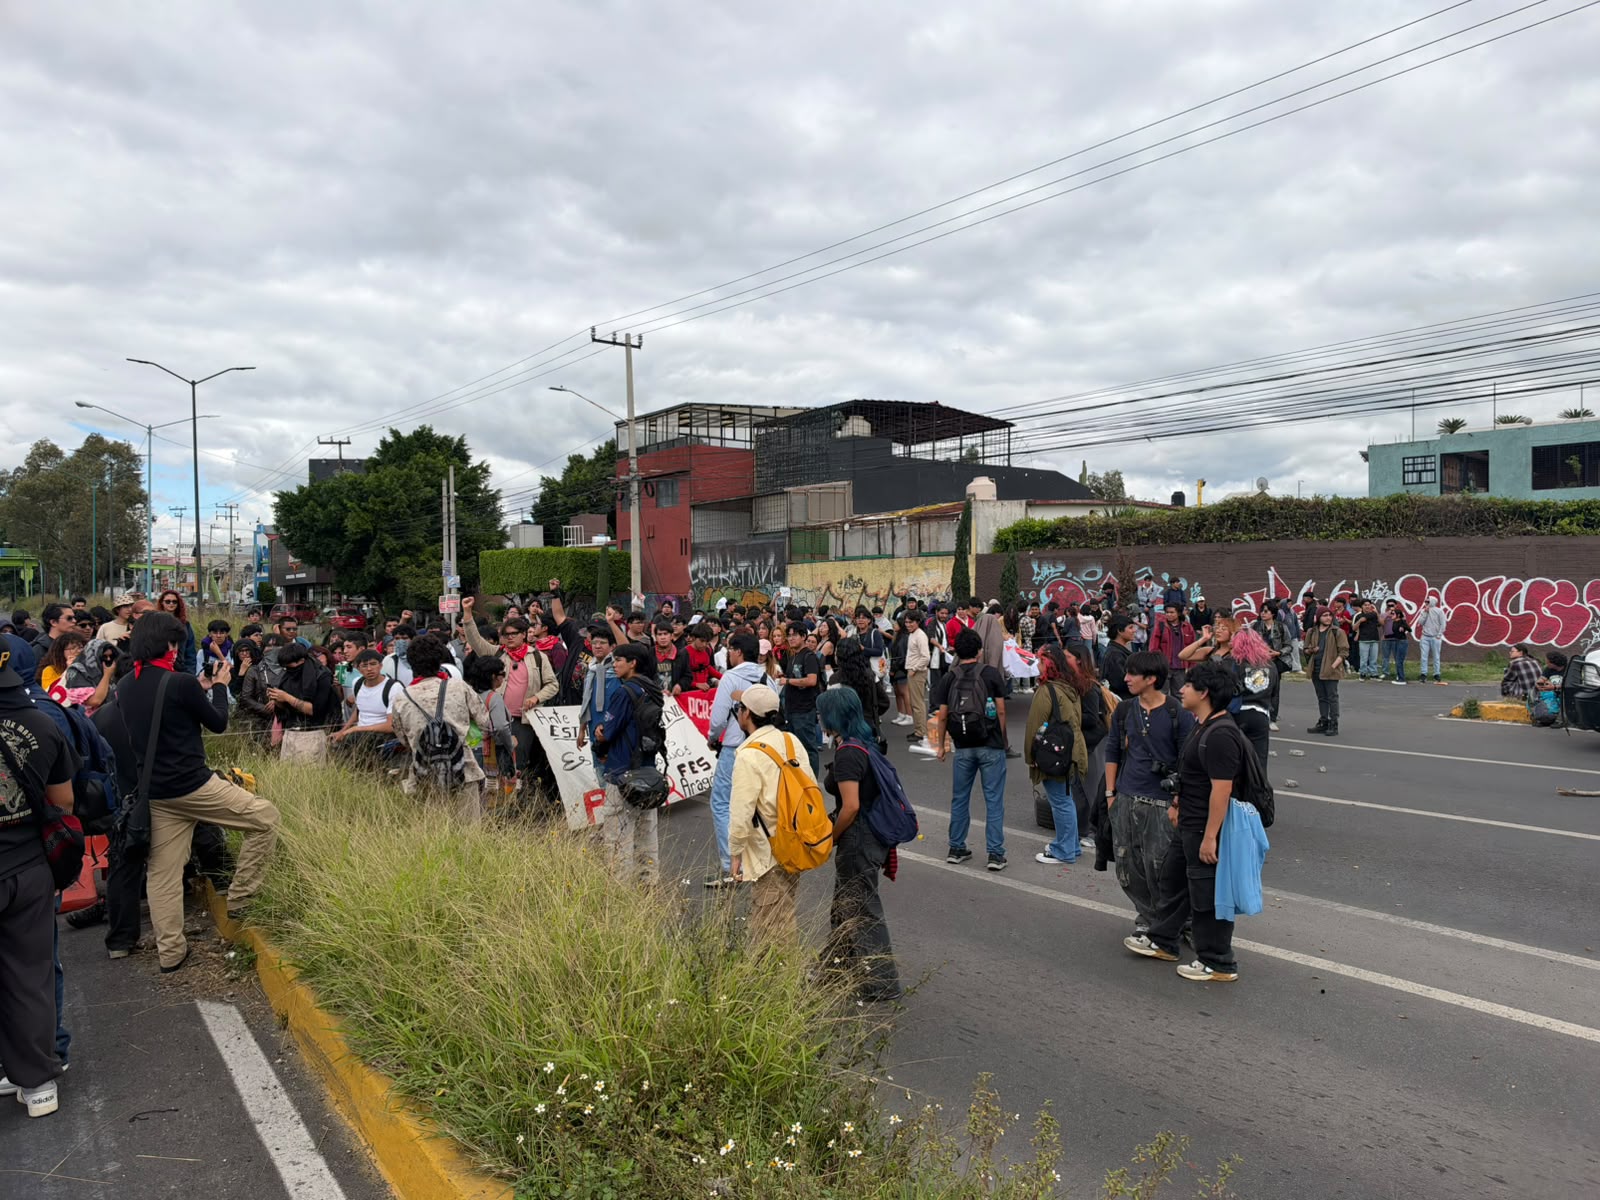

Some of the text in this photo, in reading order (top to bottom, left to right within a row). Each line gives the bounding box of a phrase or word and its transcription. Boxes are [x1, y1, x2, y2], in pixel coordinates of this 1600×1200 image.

[534, 708, 571, 726] Ante
[16, 724, 39, 750] MASTER
[677, 756, 711, 778] FES
[32, 1095, 54, 1105] adidas
